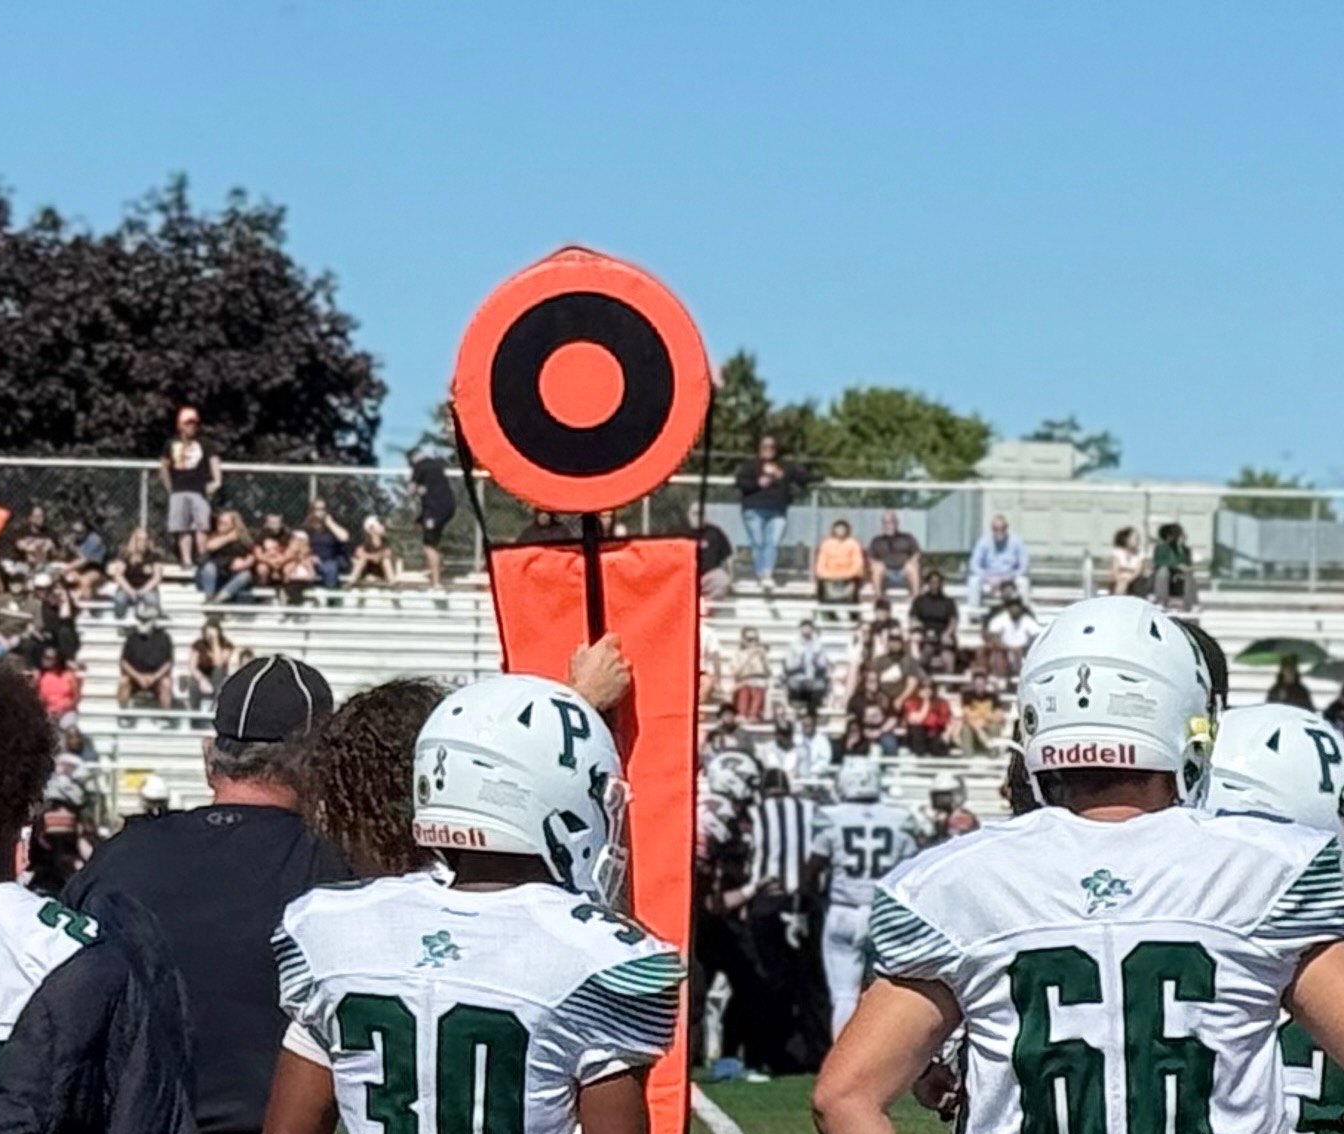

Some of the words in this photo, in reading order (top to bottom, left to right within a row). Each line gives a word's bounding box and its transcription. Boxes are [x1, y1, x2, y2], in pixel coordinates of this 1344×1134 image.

[551, 698, 591, 769] P
[1041, 742, 1135, 765] Riddell
[1304, 727, 1342, 794] P
[841, 825, 894, 879] 52
